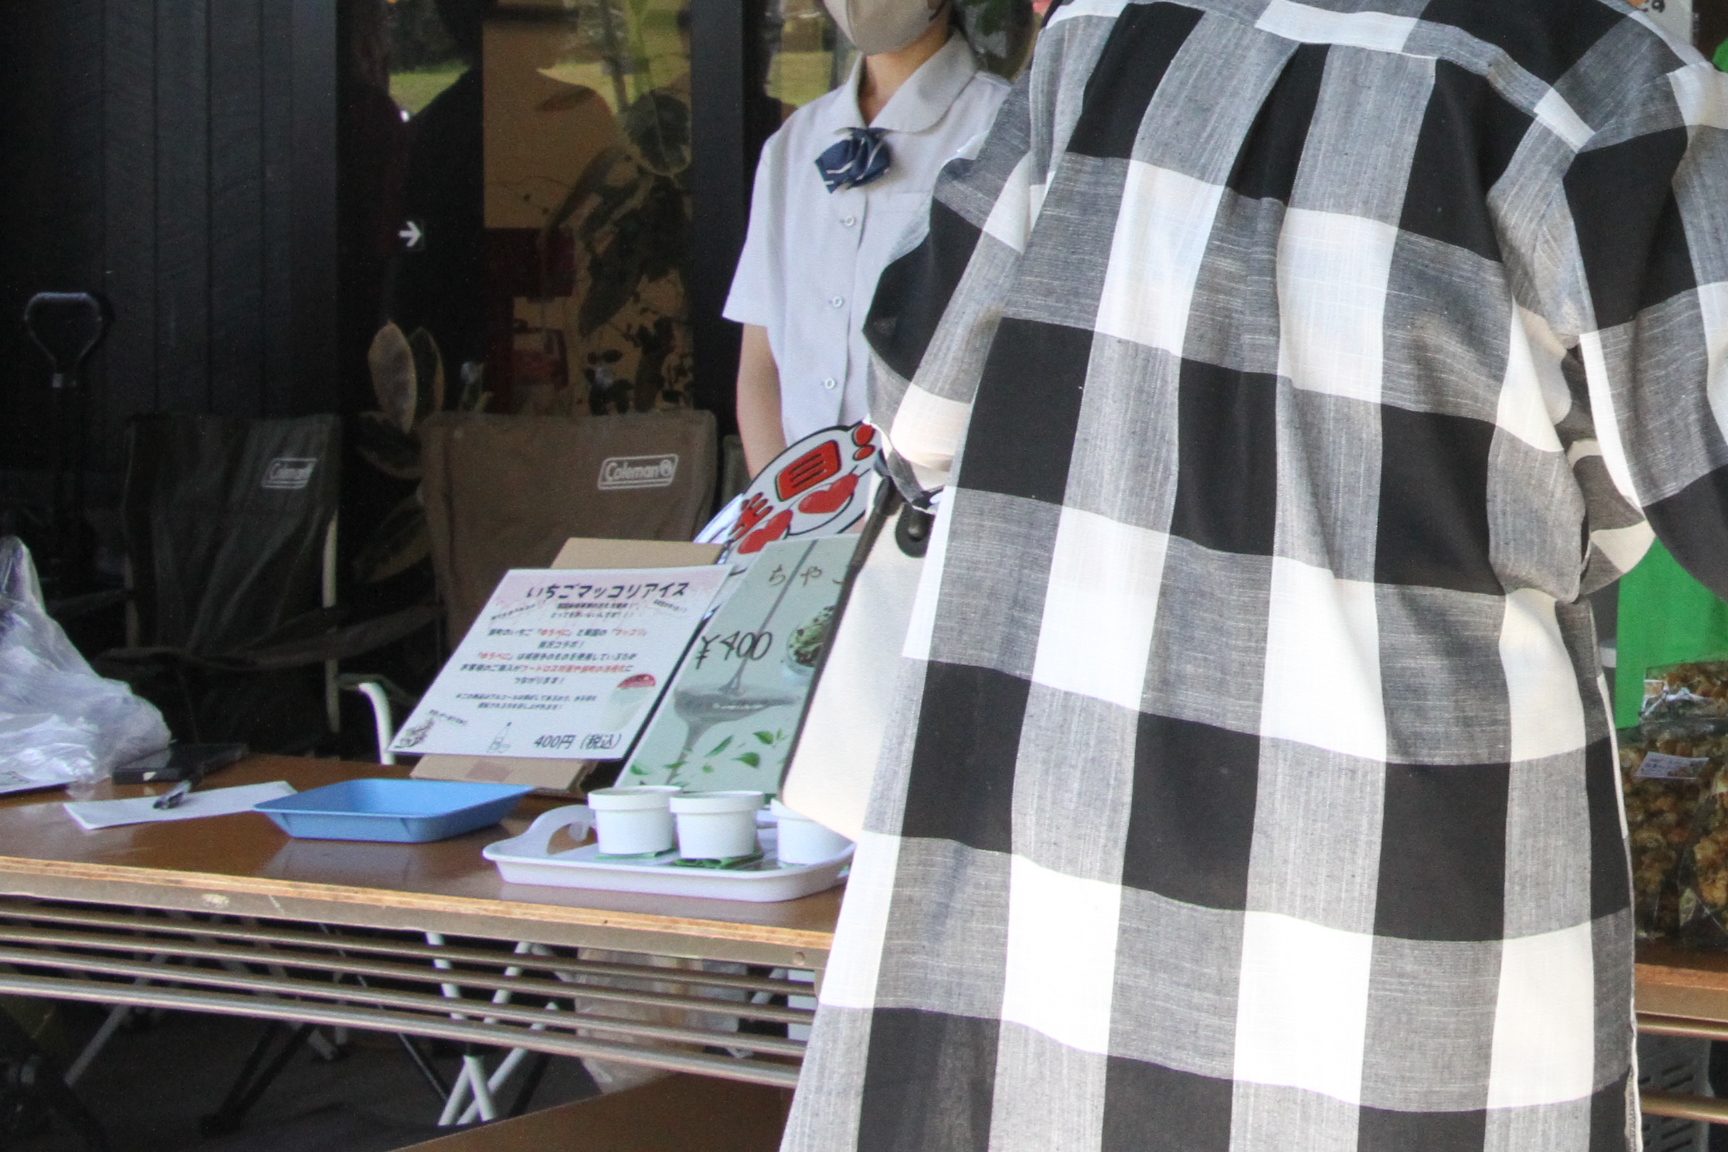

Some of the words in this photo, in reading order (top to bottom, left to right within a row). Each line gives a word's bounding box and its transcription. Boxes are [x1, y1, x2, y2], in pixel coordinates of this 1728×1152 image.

[604, 461, 660, 481] Coleman
[525, 581, 691, 600] いちごマッコリアイス
